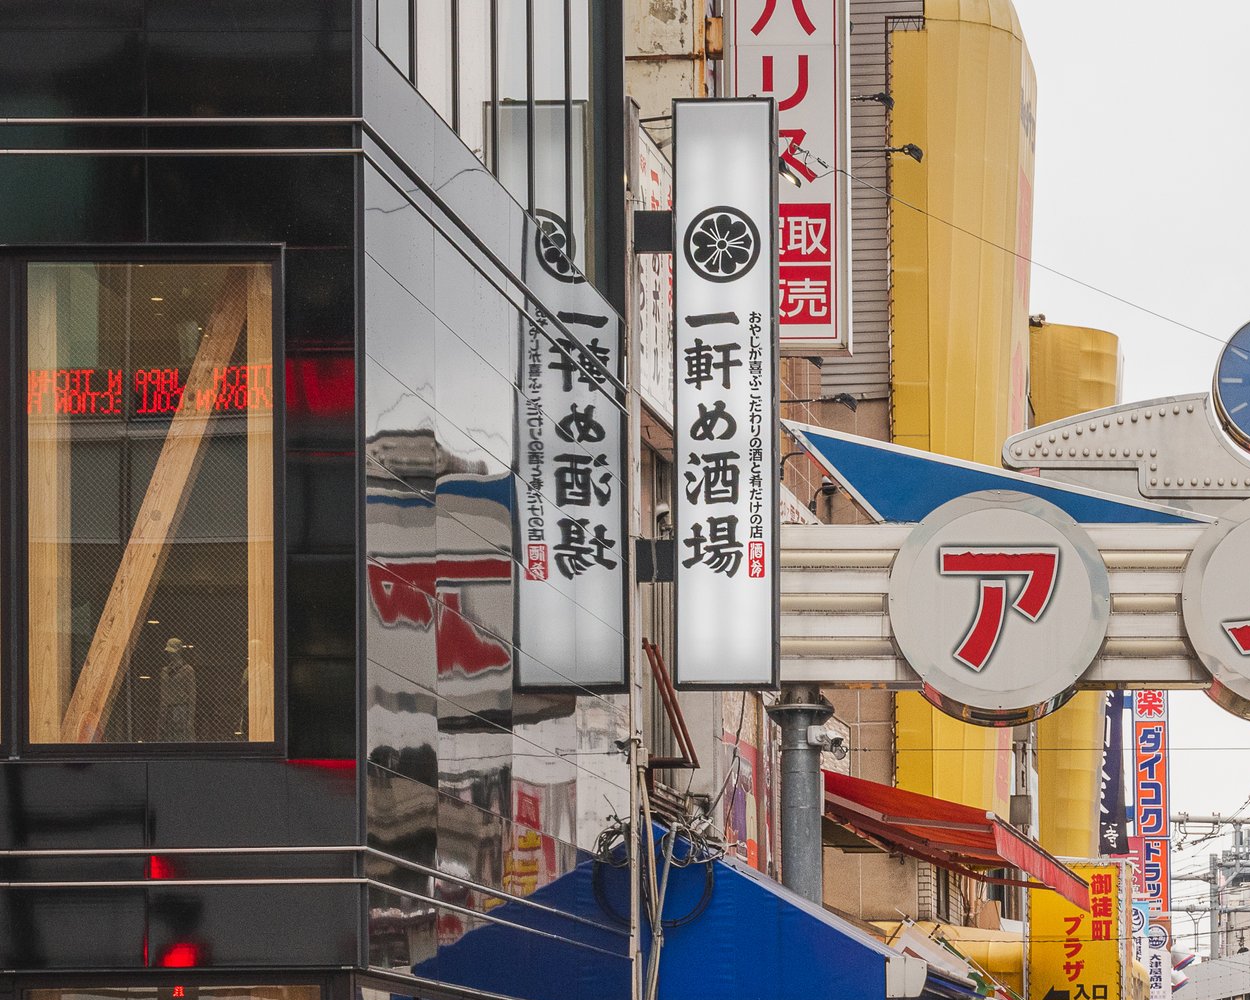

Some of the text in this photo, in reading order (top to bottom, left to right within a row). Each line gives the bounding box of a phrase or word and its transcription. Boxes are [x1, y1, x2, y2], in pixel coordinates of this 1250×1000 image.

[779, 216, 827, 255] 取
[682, 311, 743, 578] 一軒め酒場
[748, 311, 763, 539] おやじが喜ぶこだわりの酒と肴だけの店
[1091, 874, 1112, 941] 御徒町
[1063, 914, 1085, 982] プラザ
[1074, 984, 1107, 1000] 入口
